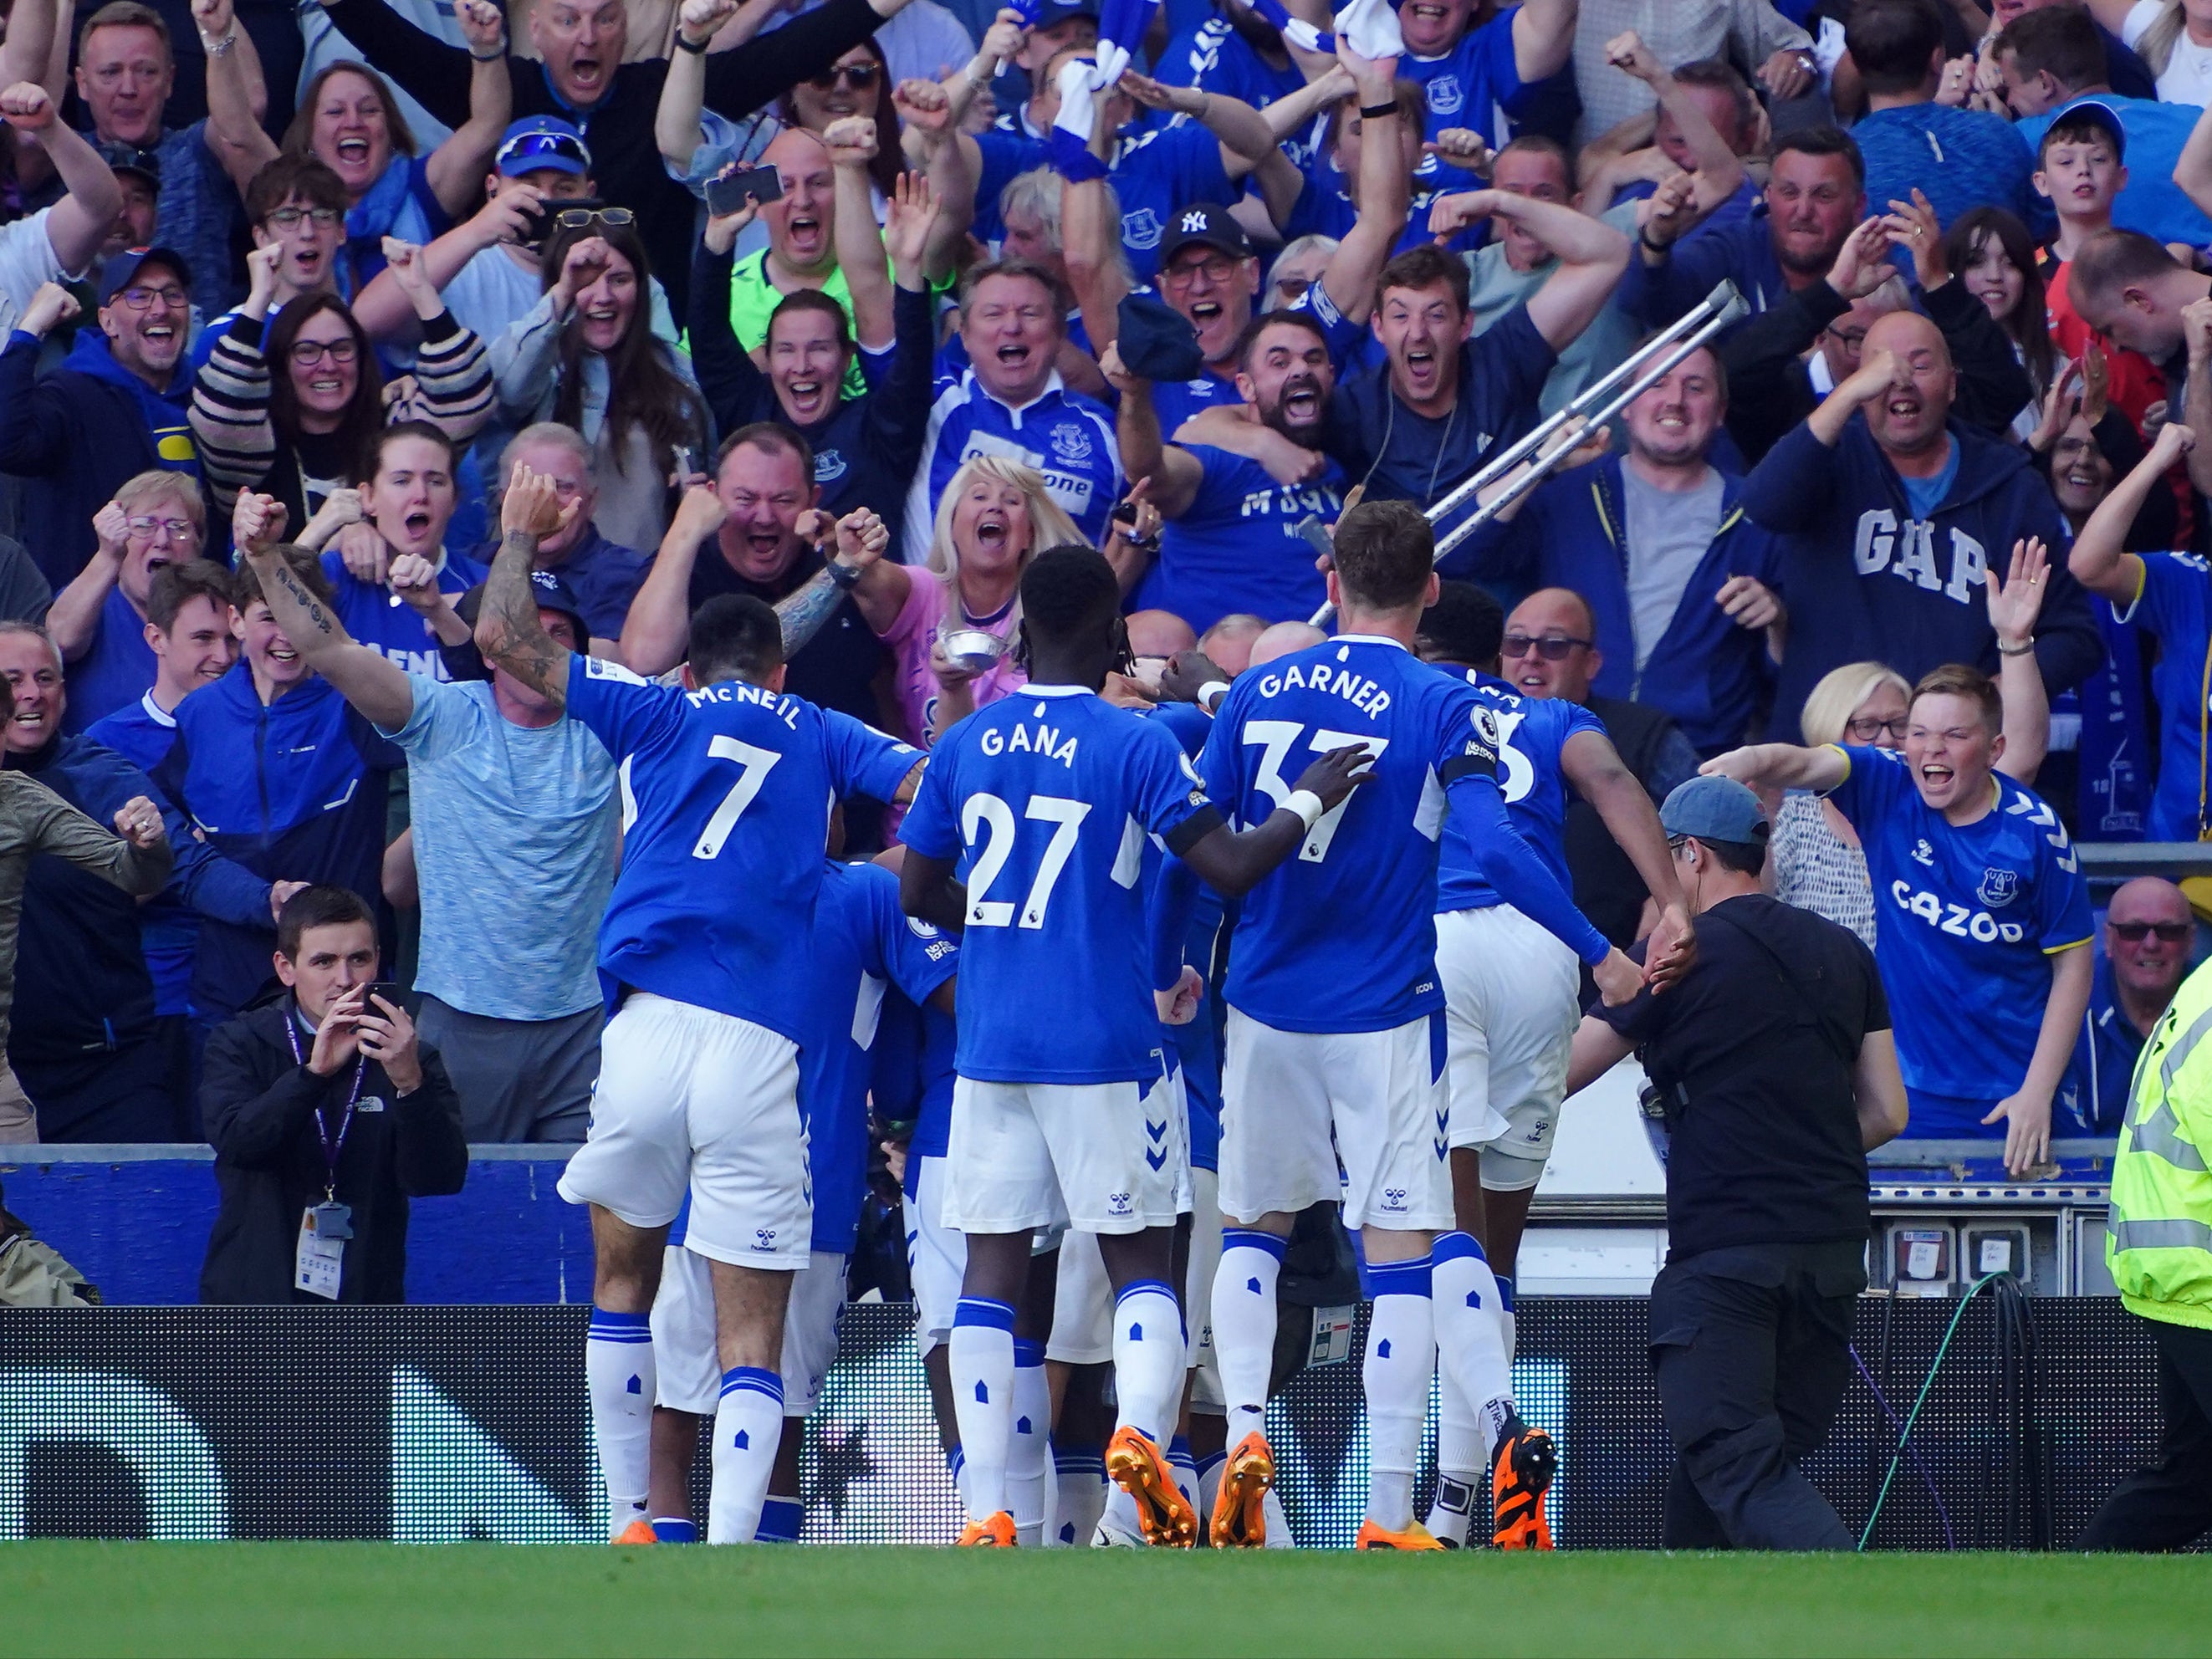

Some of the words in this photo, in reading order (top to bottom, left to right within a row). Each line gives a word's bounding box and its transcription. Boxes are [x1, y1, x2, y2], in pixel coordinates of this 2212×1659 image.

[1855, 508, 1988, 605] GAP
[981, 722, 1078, 768] GANA
[1259, 664, 1391, 721] GARNER
[692, 734, 783, 860] 7
[1243, 720, 1390, 863] 37
[962, 792, 1093, 930] 27
